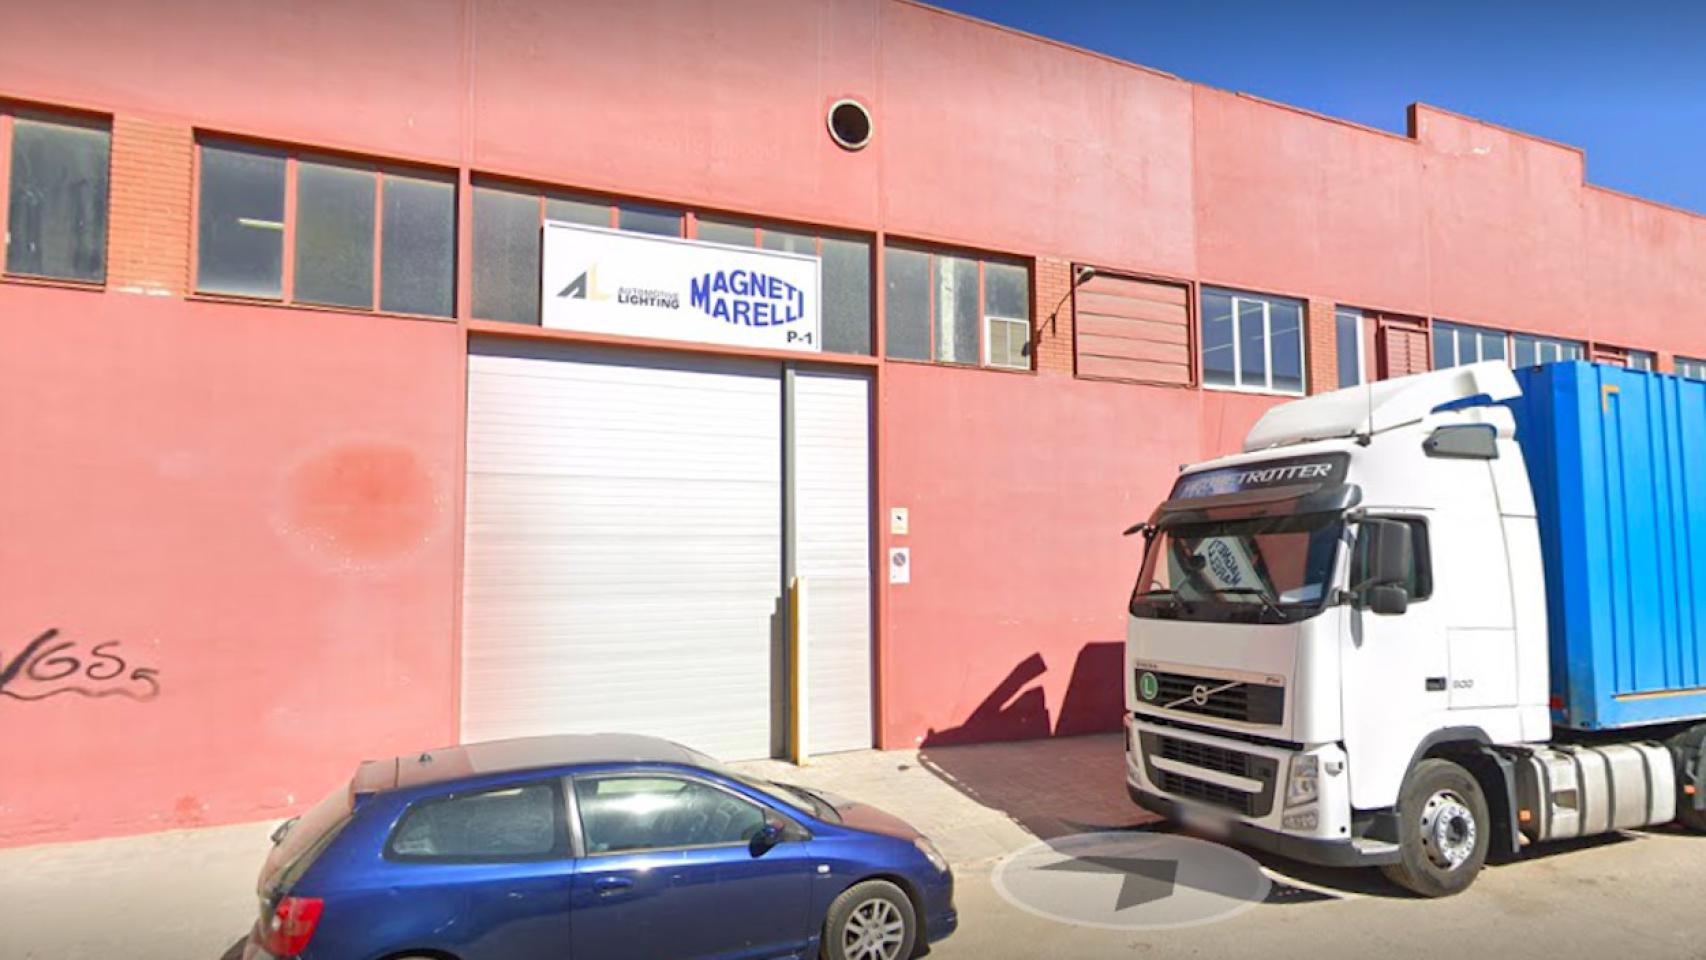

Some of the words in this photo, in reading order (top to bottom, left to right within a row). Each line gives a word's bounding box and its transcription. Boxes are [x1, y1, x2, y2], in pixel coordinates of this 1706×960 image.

[618, 293, 679, 310] LIGHTING
[690, 269, 804, 318] MAGNETI
[690, 277, 804, 326] MARELLI
[786, 330, 812, 344] P-1
[1144, 678, 1153, 695] L
